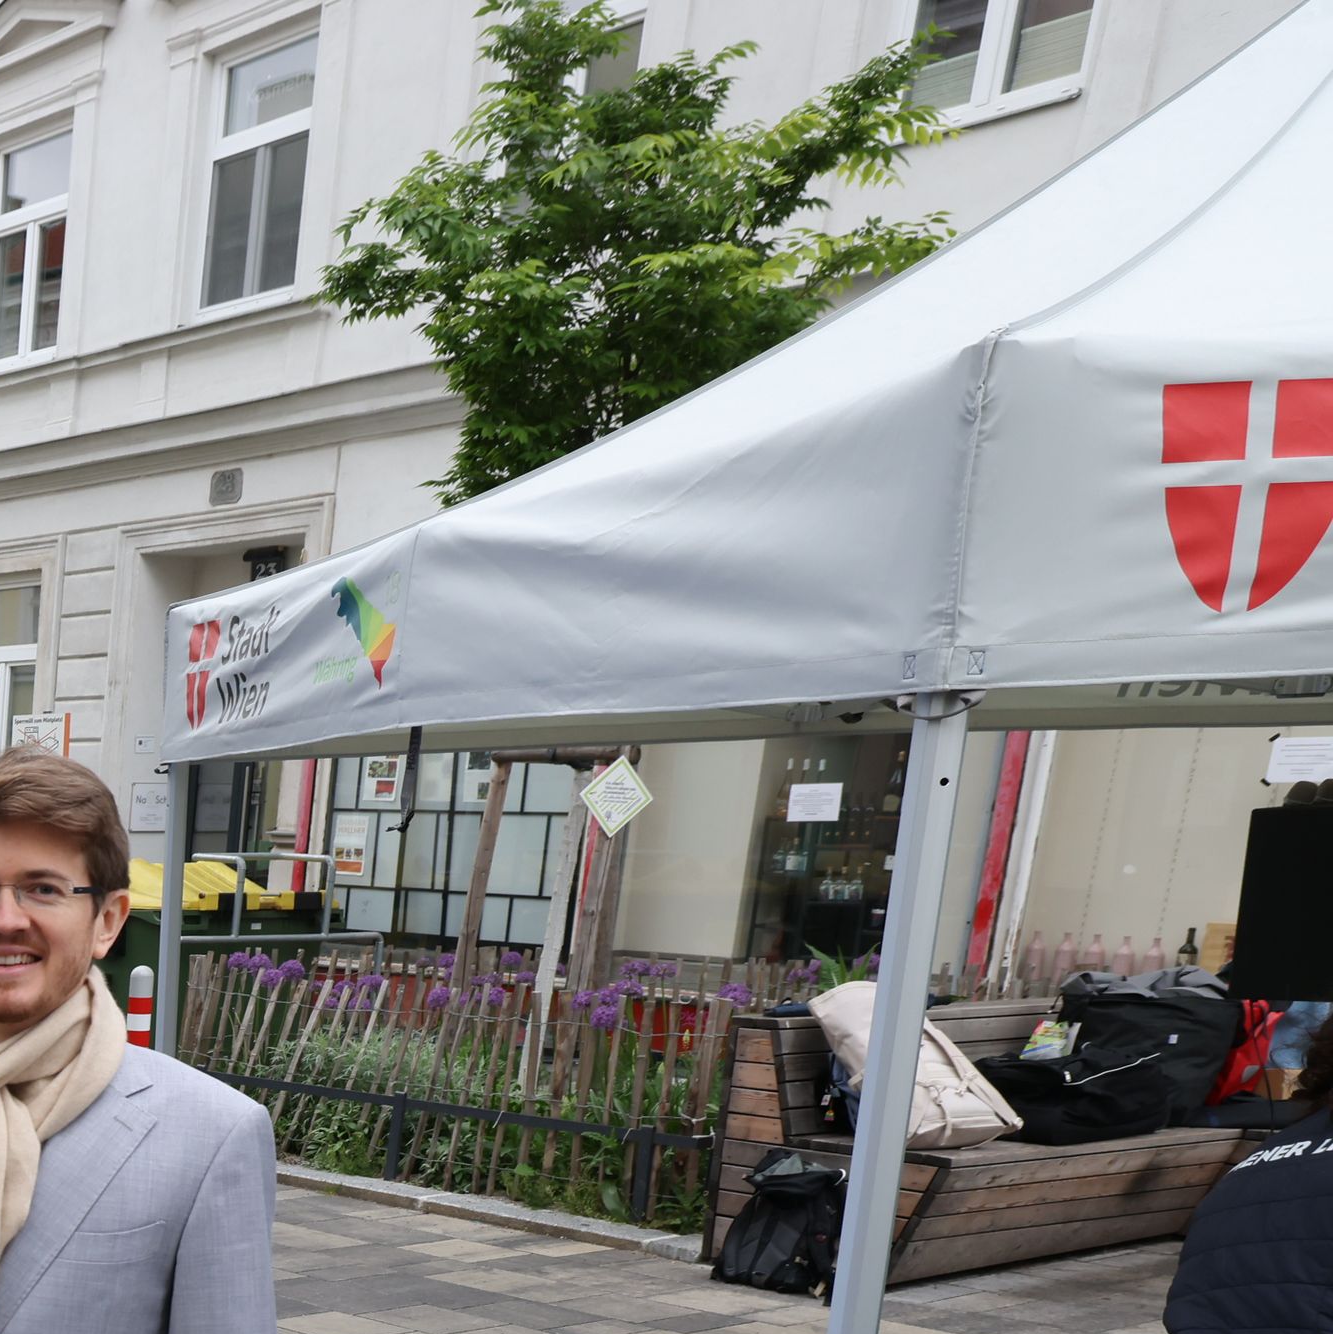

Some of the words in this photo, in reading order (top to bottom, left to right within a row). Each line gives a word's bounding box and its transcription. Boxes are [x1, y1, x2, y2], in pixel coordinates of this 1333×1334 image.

[255, 561, 278, 581] 23
[221, 605, 280, 666] Stadt
[313, 655, 357, 690] Währing
[216, 672, 270, 724] Wien
